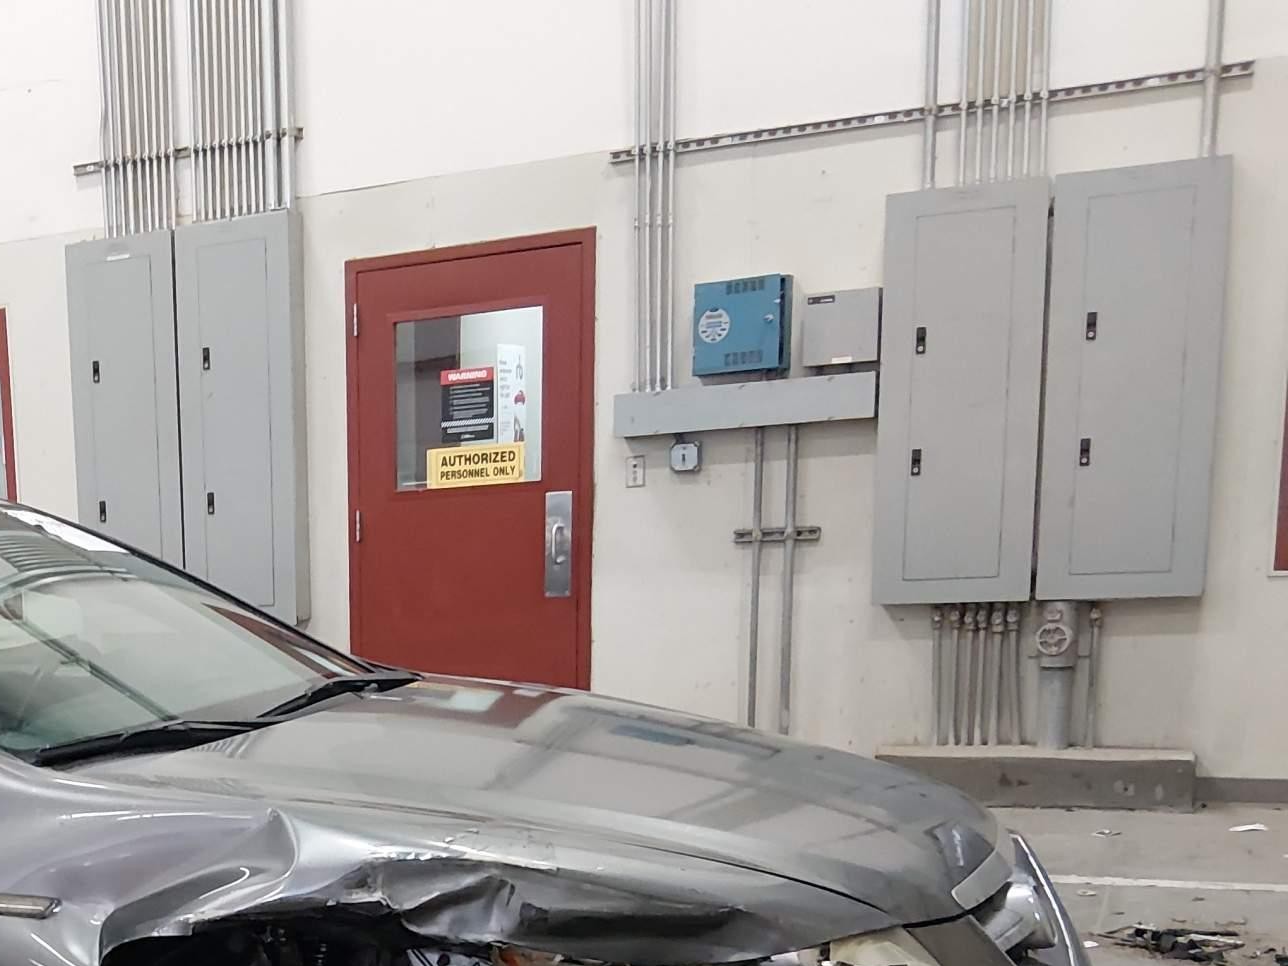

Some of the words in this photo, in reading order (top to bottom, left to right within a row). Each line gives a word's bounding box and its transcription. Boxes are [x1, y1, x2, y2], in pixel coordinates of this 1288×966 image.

[447, 370, 487, 381] WARNING
[441, 451, 516, 467] AUTHORIZED
[440, 468, 490, 480] PERSONNEL
[493, 466, 516, 476] ONLY
